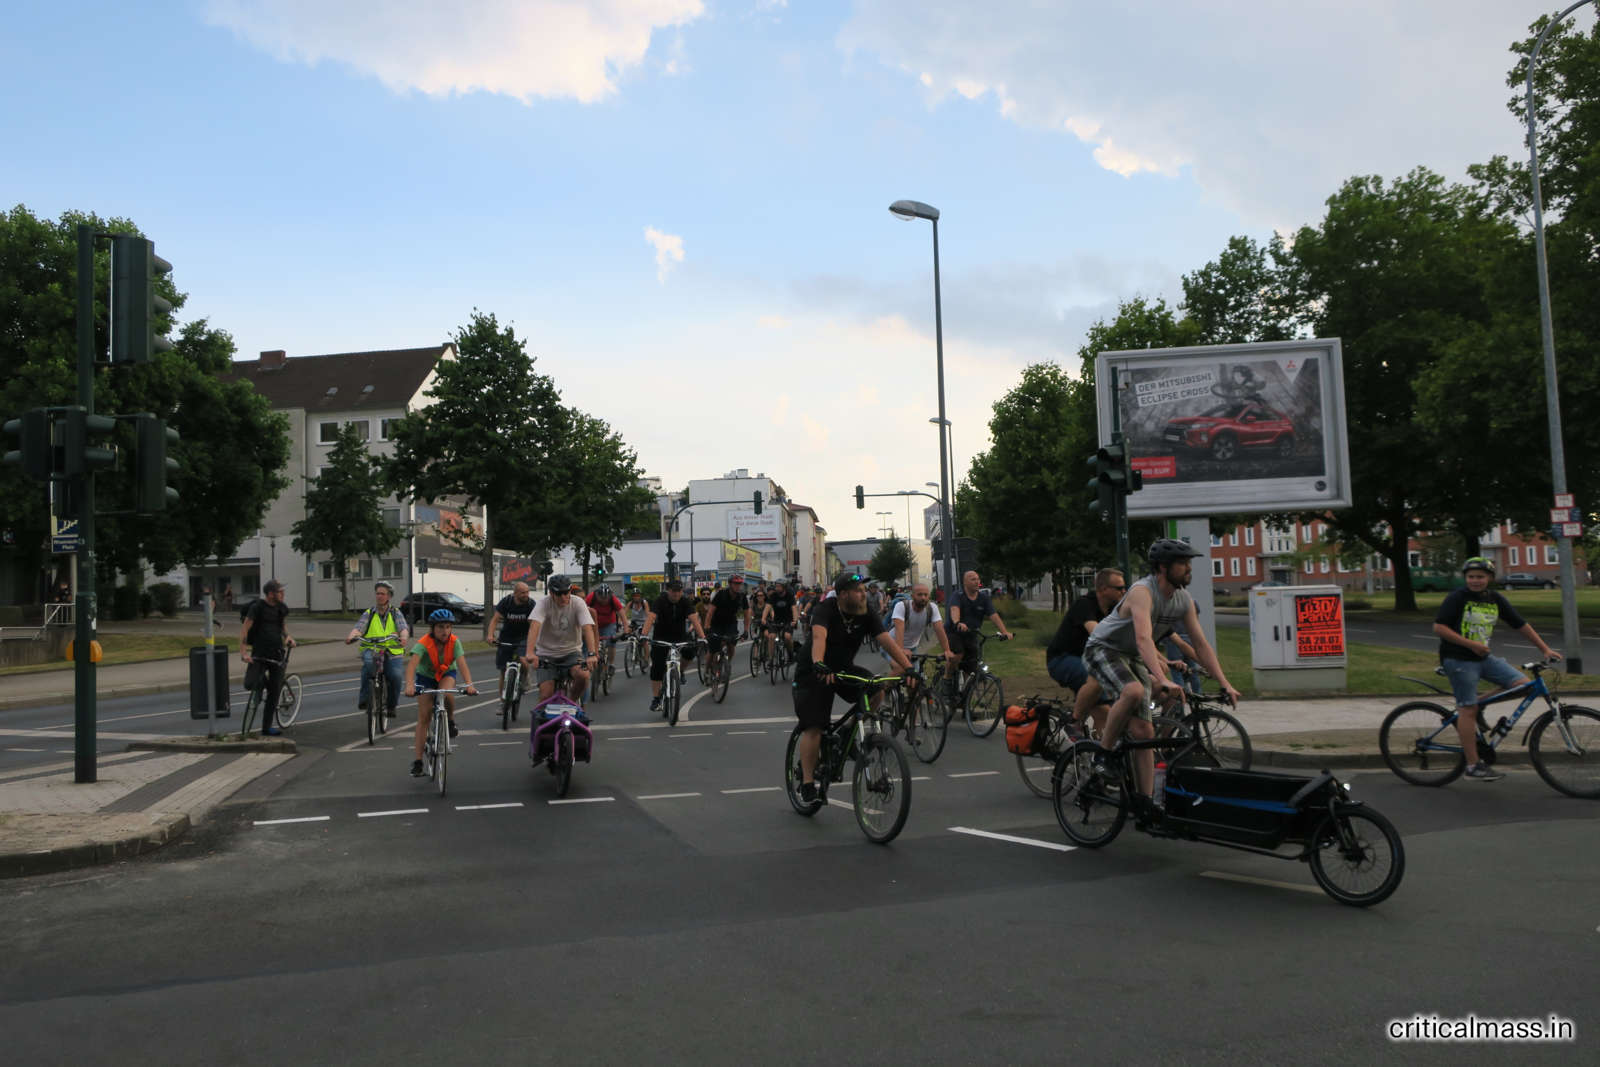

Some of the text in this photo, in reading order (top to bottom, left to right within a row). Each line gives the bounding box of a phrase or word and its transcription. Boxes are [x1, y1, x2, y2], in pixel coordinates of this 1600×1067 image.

[1139, 373, 1212, 393] DER MITSUBISHI
[1141, 386, 1209, 405] ECLIPSE CROSS
